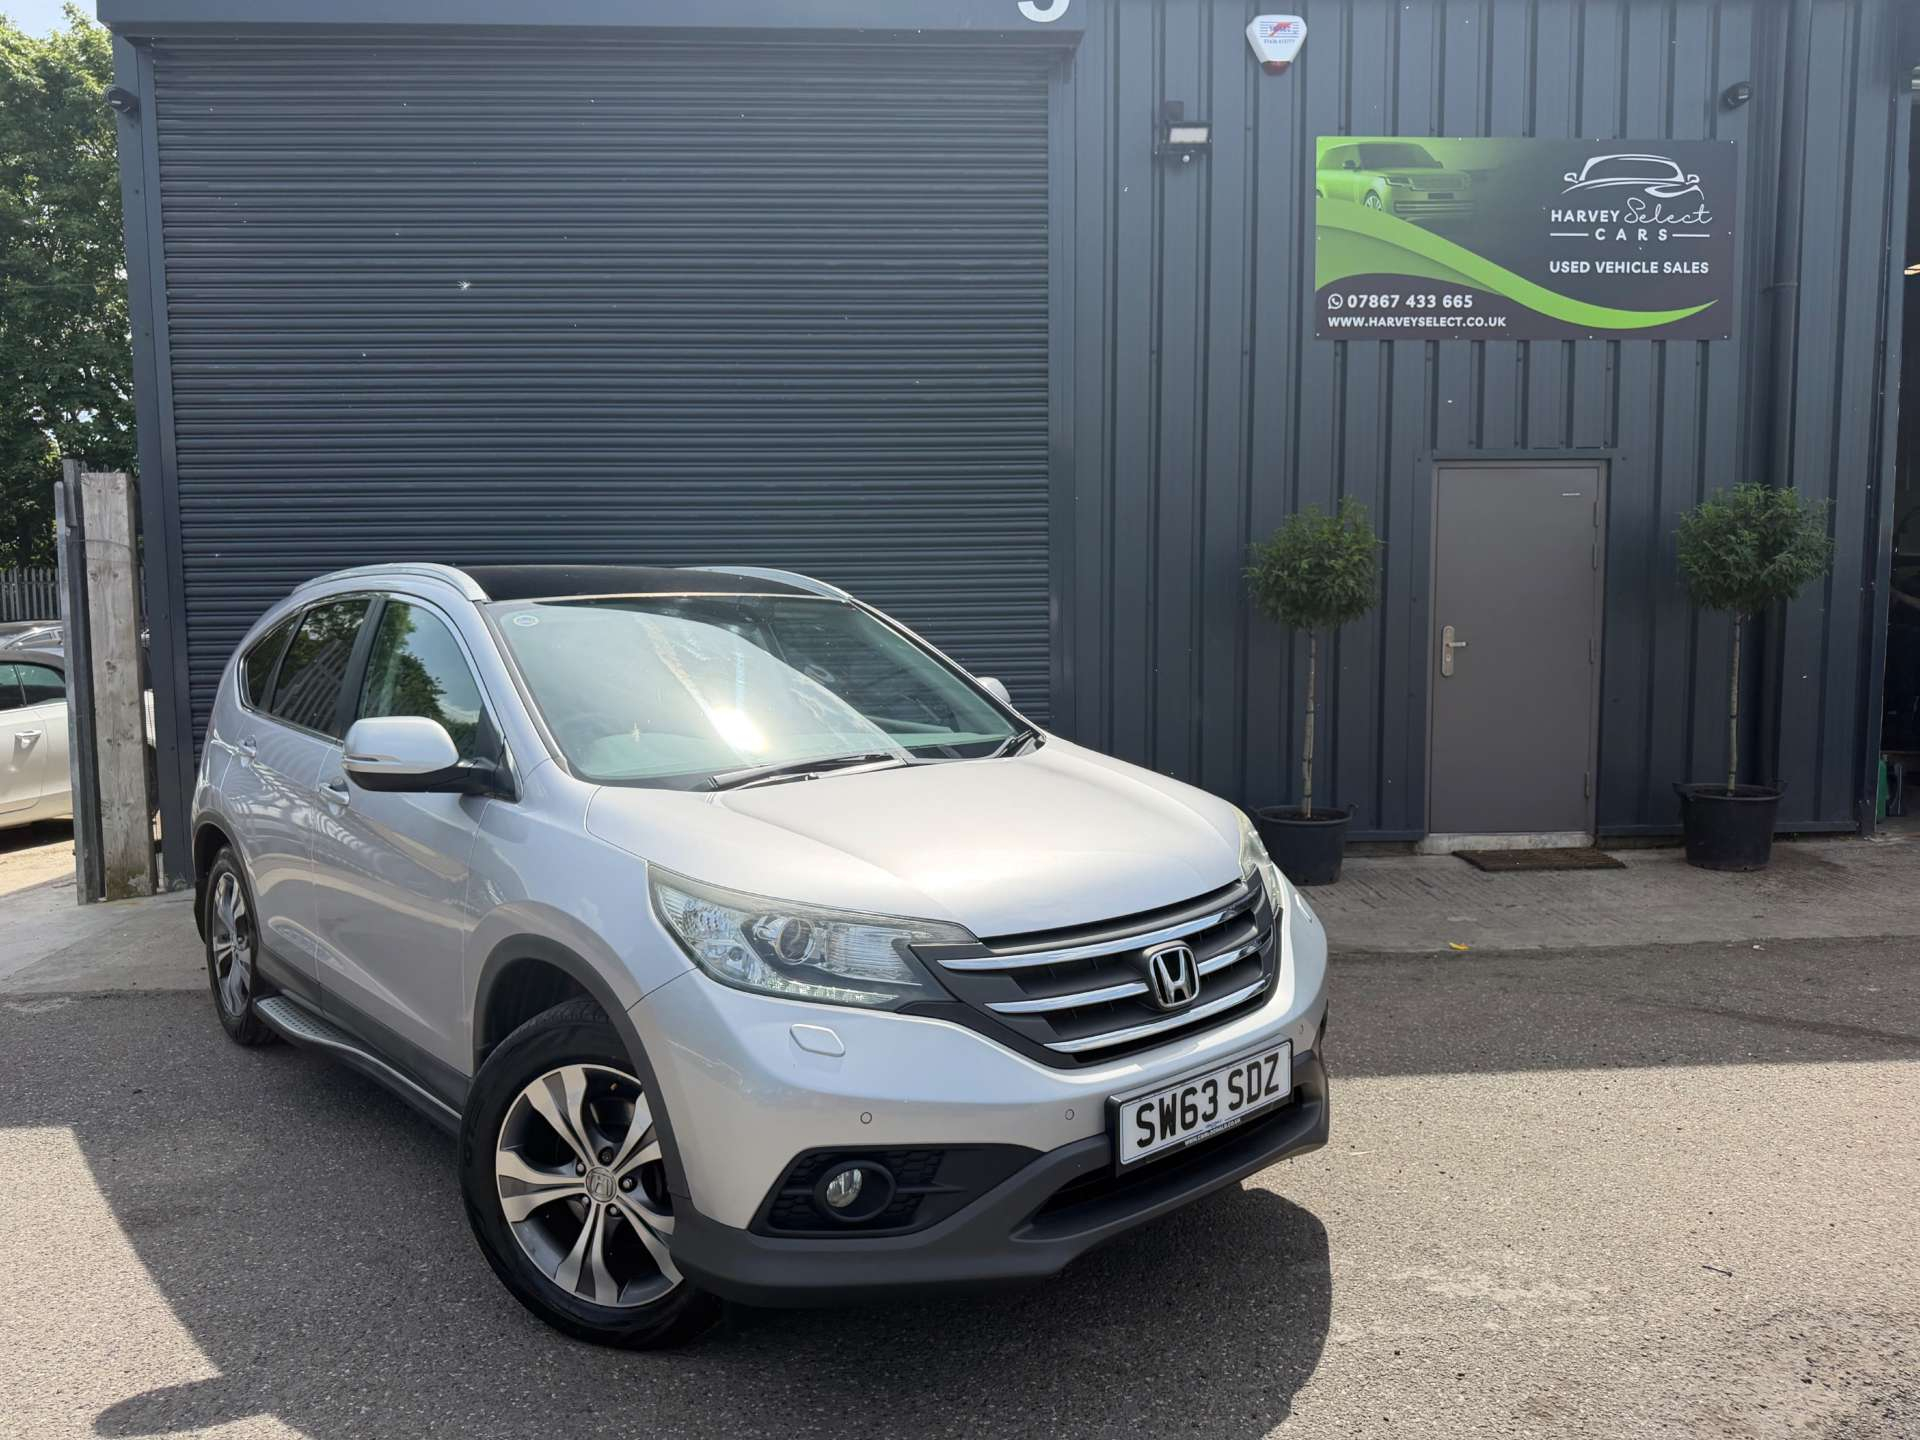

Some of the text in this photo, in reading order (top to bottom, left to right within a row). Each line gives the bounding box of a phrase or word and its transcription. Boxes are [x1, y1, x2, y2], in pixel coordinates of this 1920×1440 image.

[1551, 197, 1713, 224] HARVEY Select
[1595, 227, 1668, 241] CARS
[1549, 261, 1709, 274] USED VEHICLE SALES
[1347, 294, 1473, 308] 07867 433 665
[1328, 316, 1506, 327] WWW.HARVEYSELECT.CO.UK
[1136, 1078, 1218, 1149] SW63
[1227, 1052, 1279, 1112] SDZ
